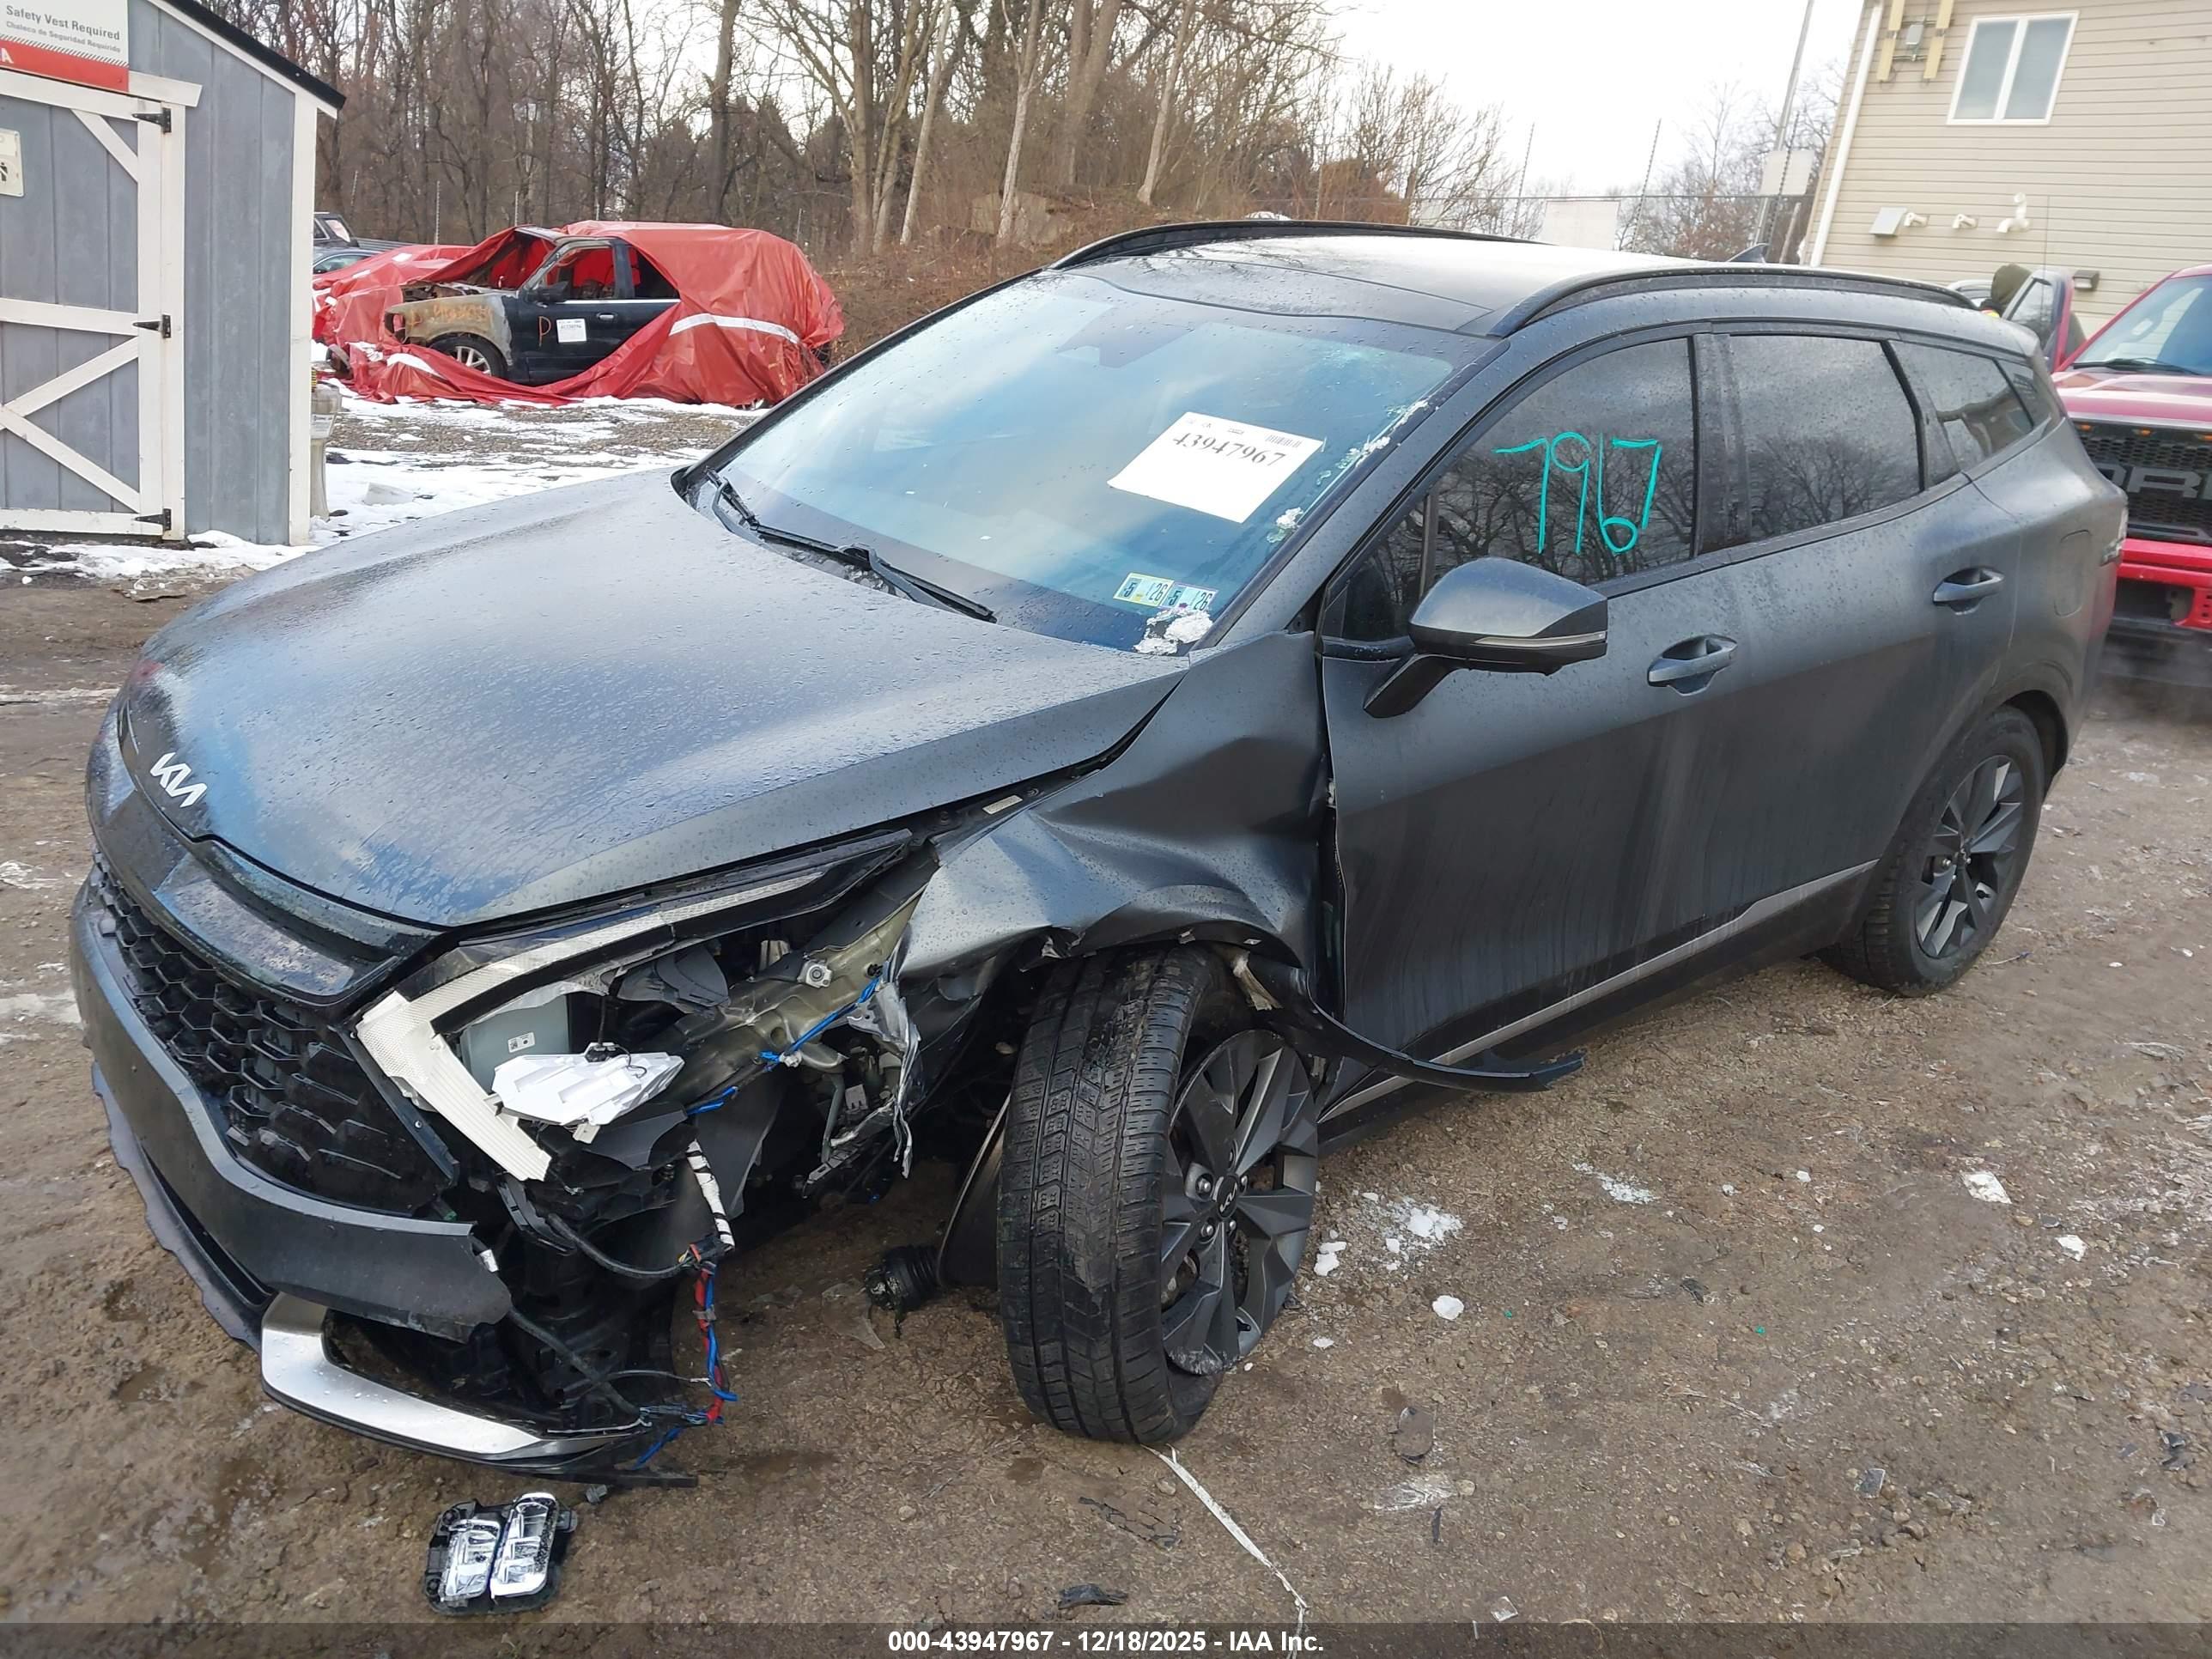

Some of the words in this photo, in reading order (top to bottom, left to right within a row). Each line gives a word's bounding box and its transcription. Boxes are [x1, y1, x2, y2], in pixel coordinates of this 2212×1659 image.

[7, 5, 41, 24] Safety
[45, 14, 69, 28] Vest
[72, 21, 120, 40] Required
[49, 30, 86, 46] Seguridad
[1173, 432, 1286, 466] 43947967
[1492, 430, 1662, 556] 7967
[149, 751, 208, 808] KIA
